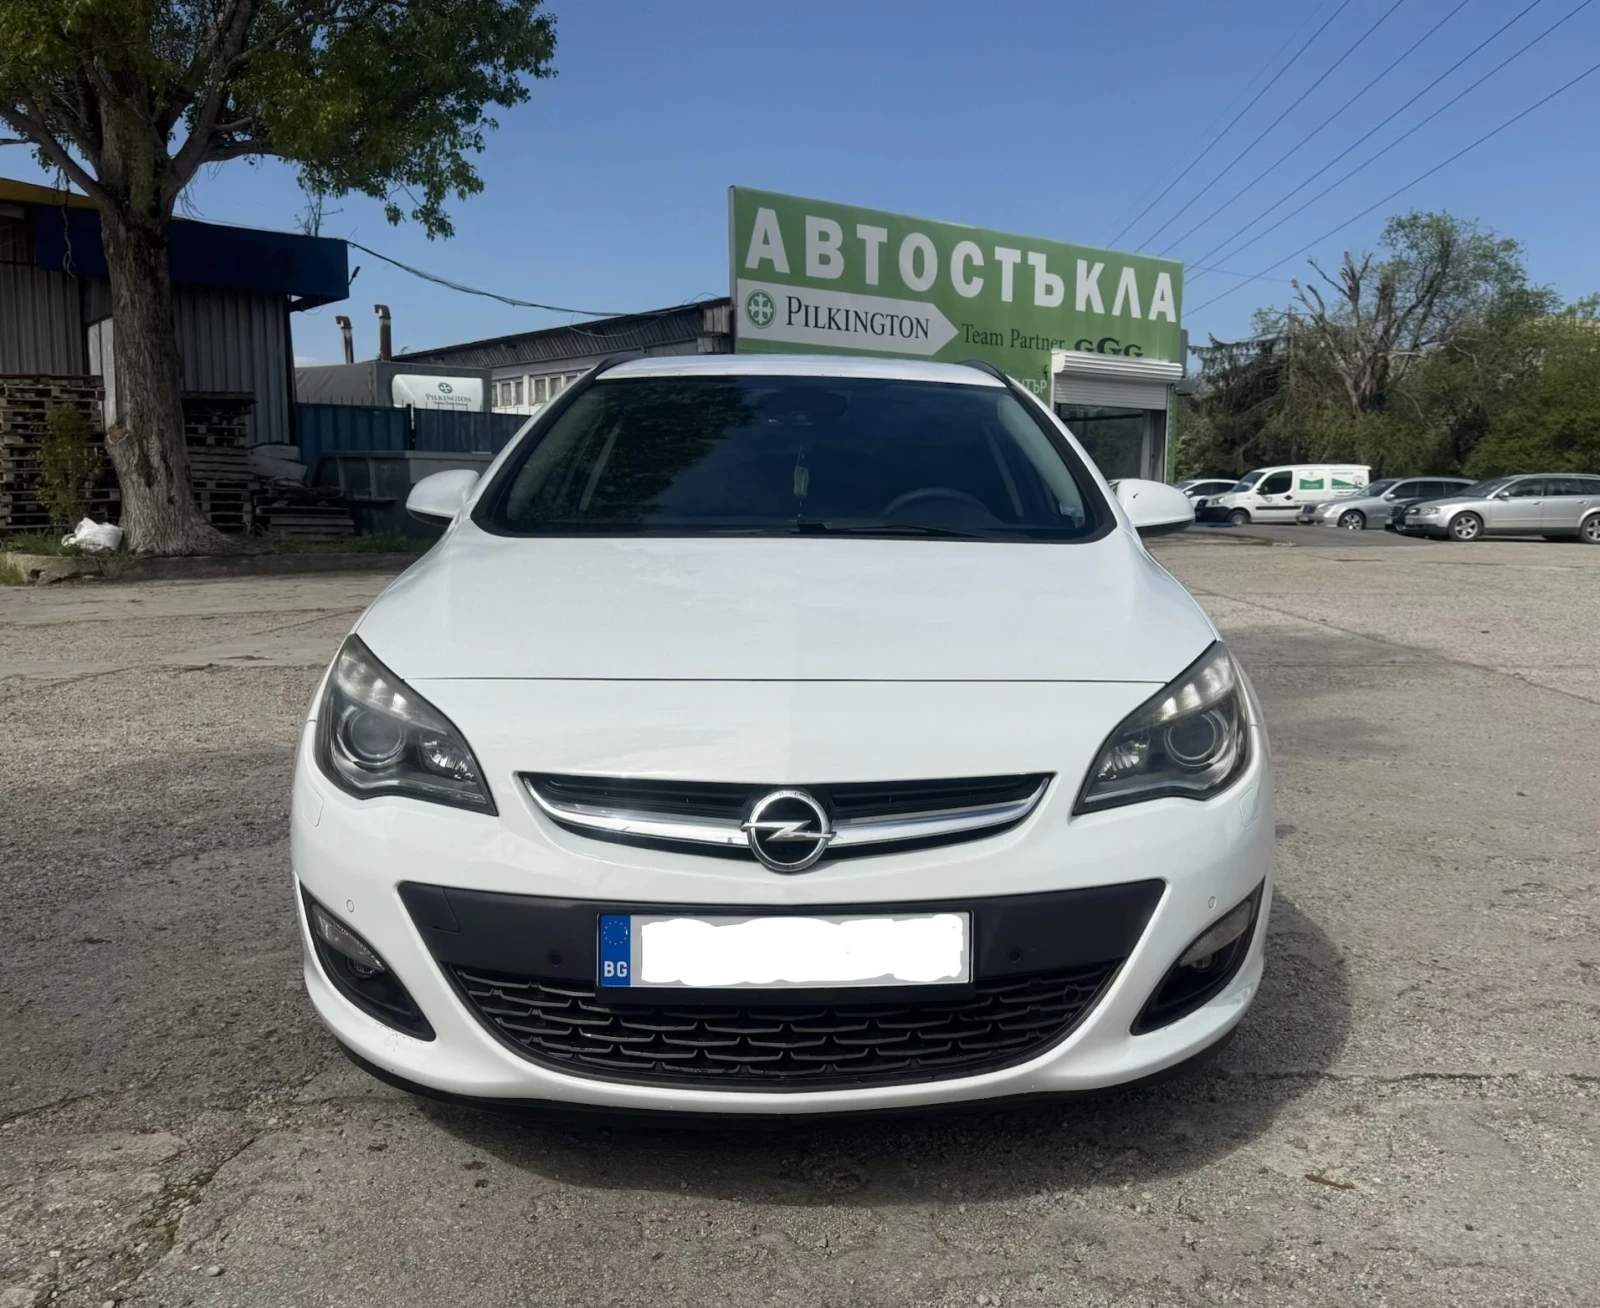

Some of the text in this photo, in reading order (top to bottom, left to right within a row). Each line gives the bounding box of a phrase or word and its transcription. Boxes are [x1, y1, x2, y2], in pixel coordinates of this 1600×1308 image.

[745, 207, 1177, 323] АВТОСТЪКЛА
[785, 295, 931, 340] PILKINGTON
[961, 323, 1004, 347] Team
[1010, 328, 1065, 349] Partner
[604, 960, 628, 977] BG
